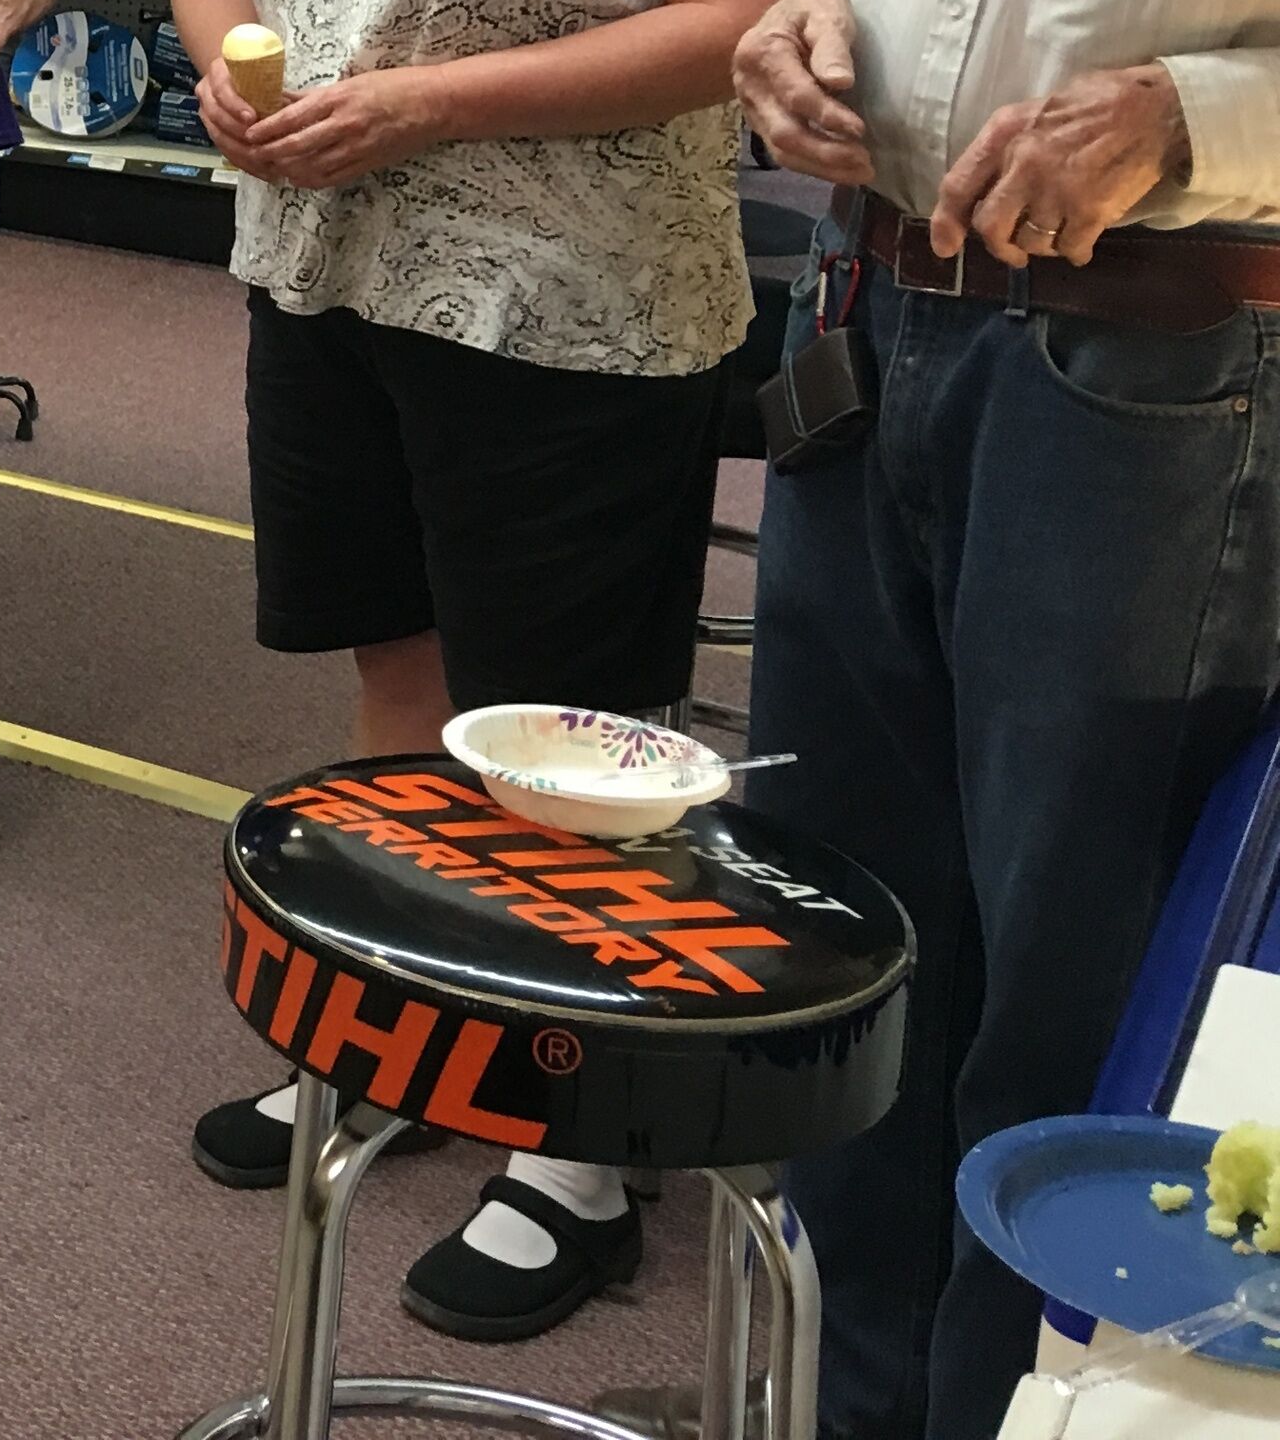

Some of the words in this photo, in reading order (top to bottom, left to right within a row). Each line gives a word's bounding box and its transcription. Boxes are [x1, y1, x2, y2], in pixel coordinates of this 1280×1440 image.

[265, 786, 721, 997] TERRITORY
[308, 773, 791, 995] STIHL
[688, 845, 864, 920] SEAT
